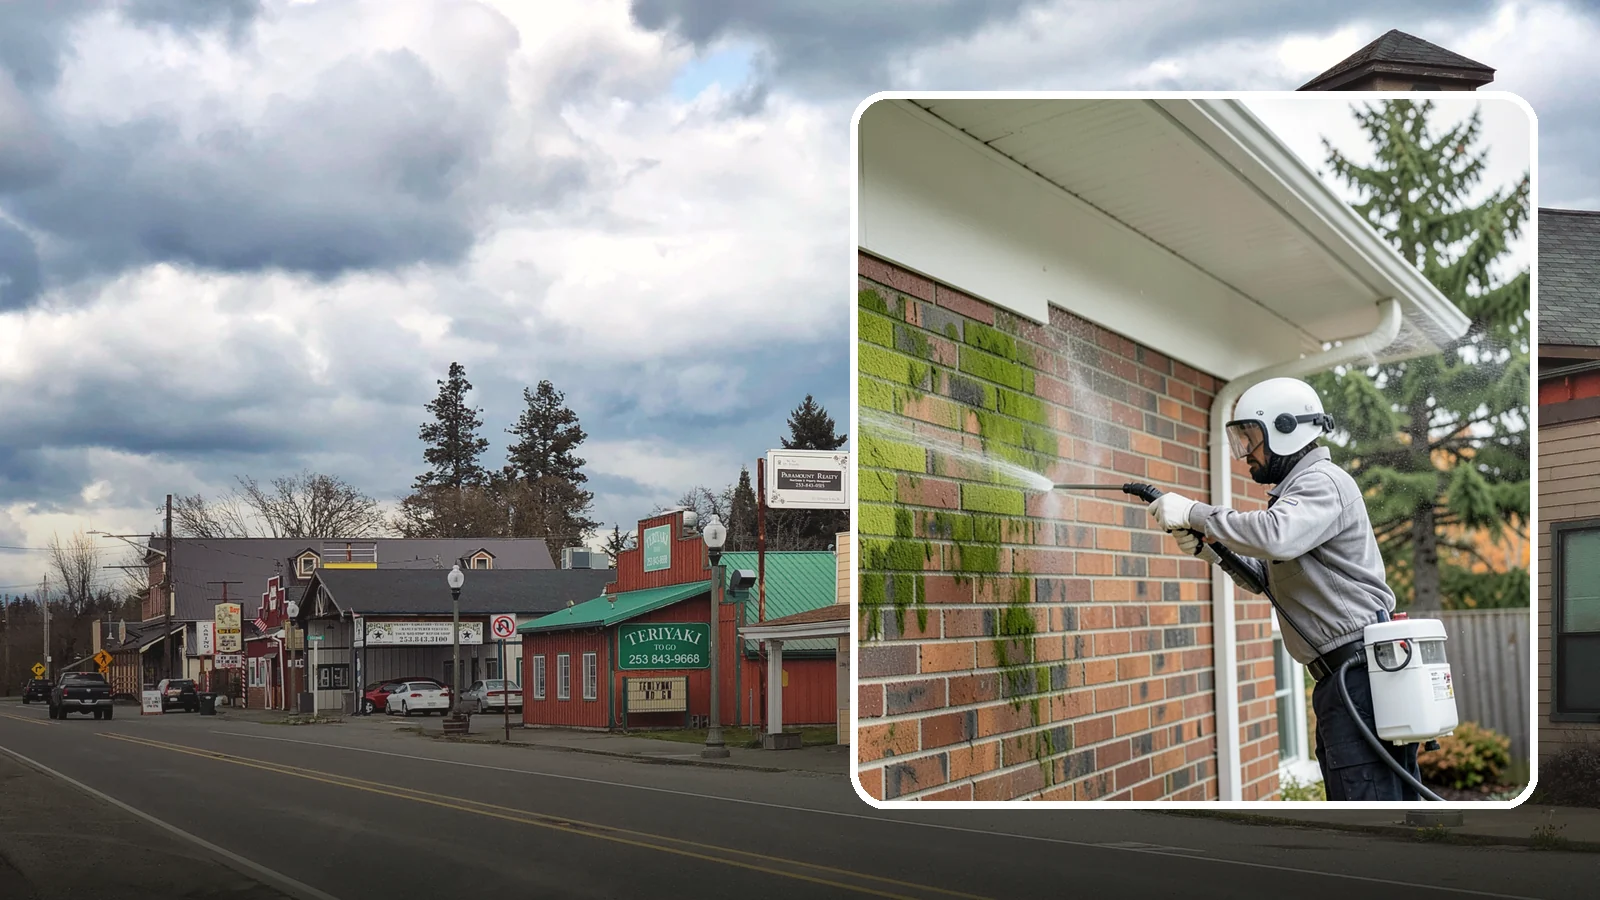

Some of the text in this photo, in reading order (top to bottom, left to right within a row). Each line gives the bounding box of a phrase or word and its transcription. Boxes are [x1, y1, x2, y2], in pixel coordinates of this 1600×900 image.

[646, 531, 669, 548] TERIYAKI
[625, 628, 702, 646] TERIYAKI
[629, 654, 700, 664] 253 843-9668
